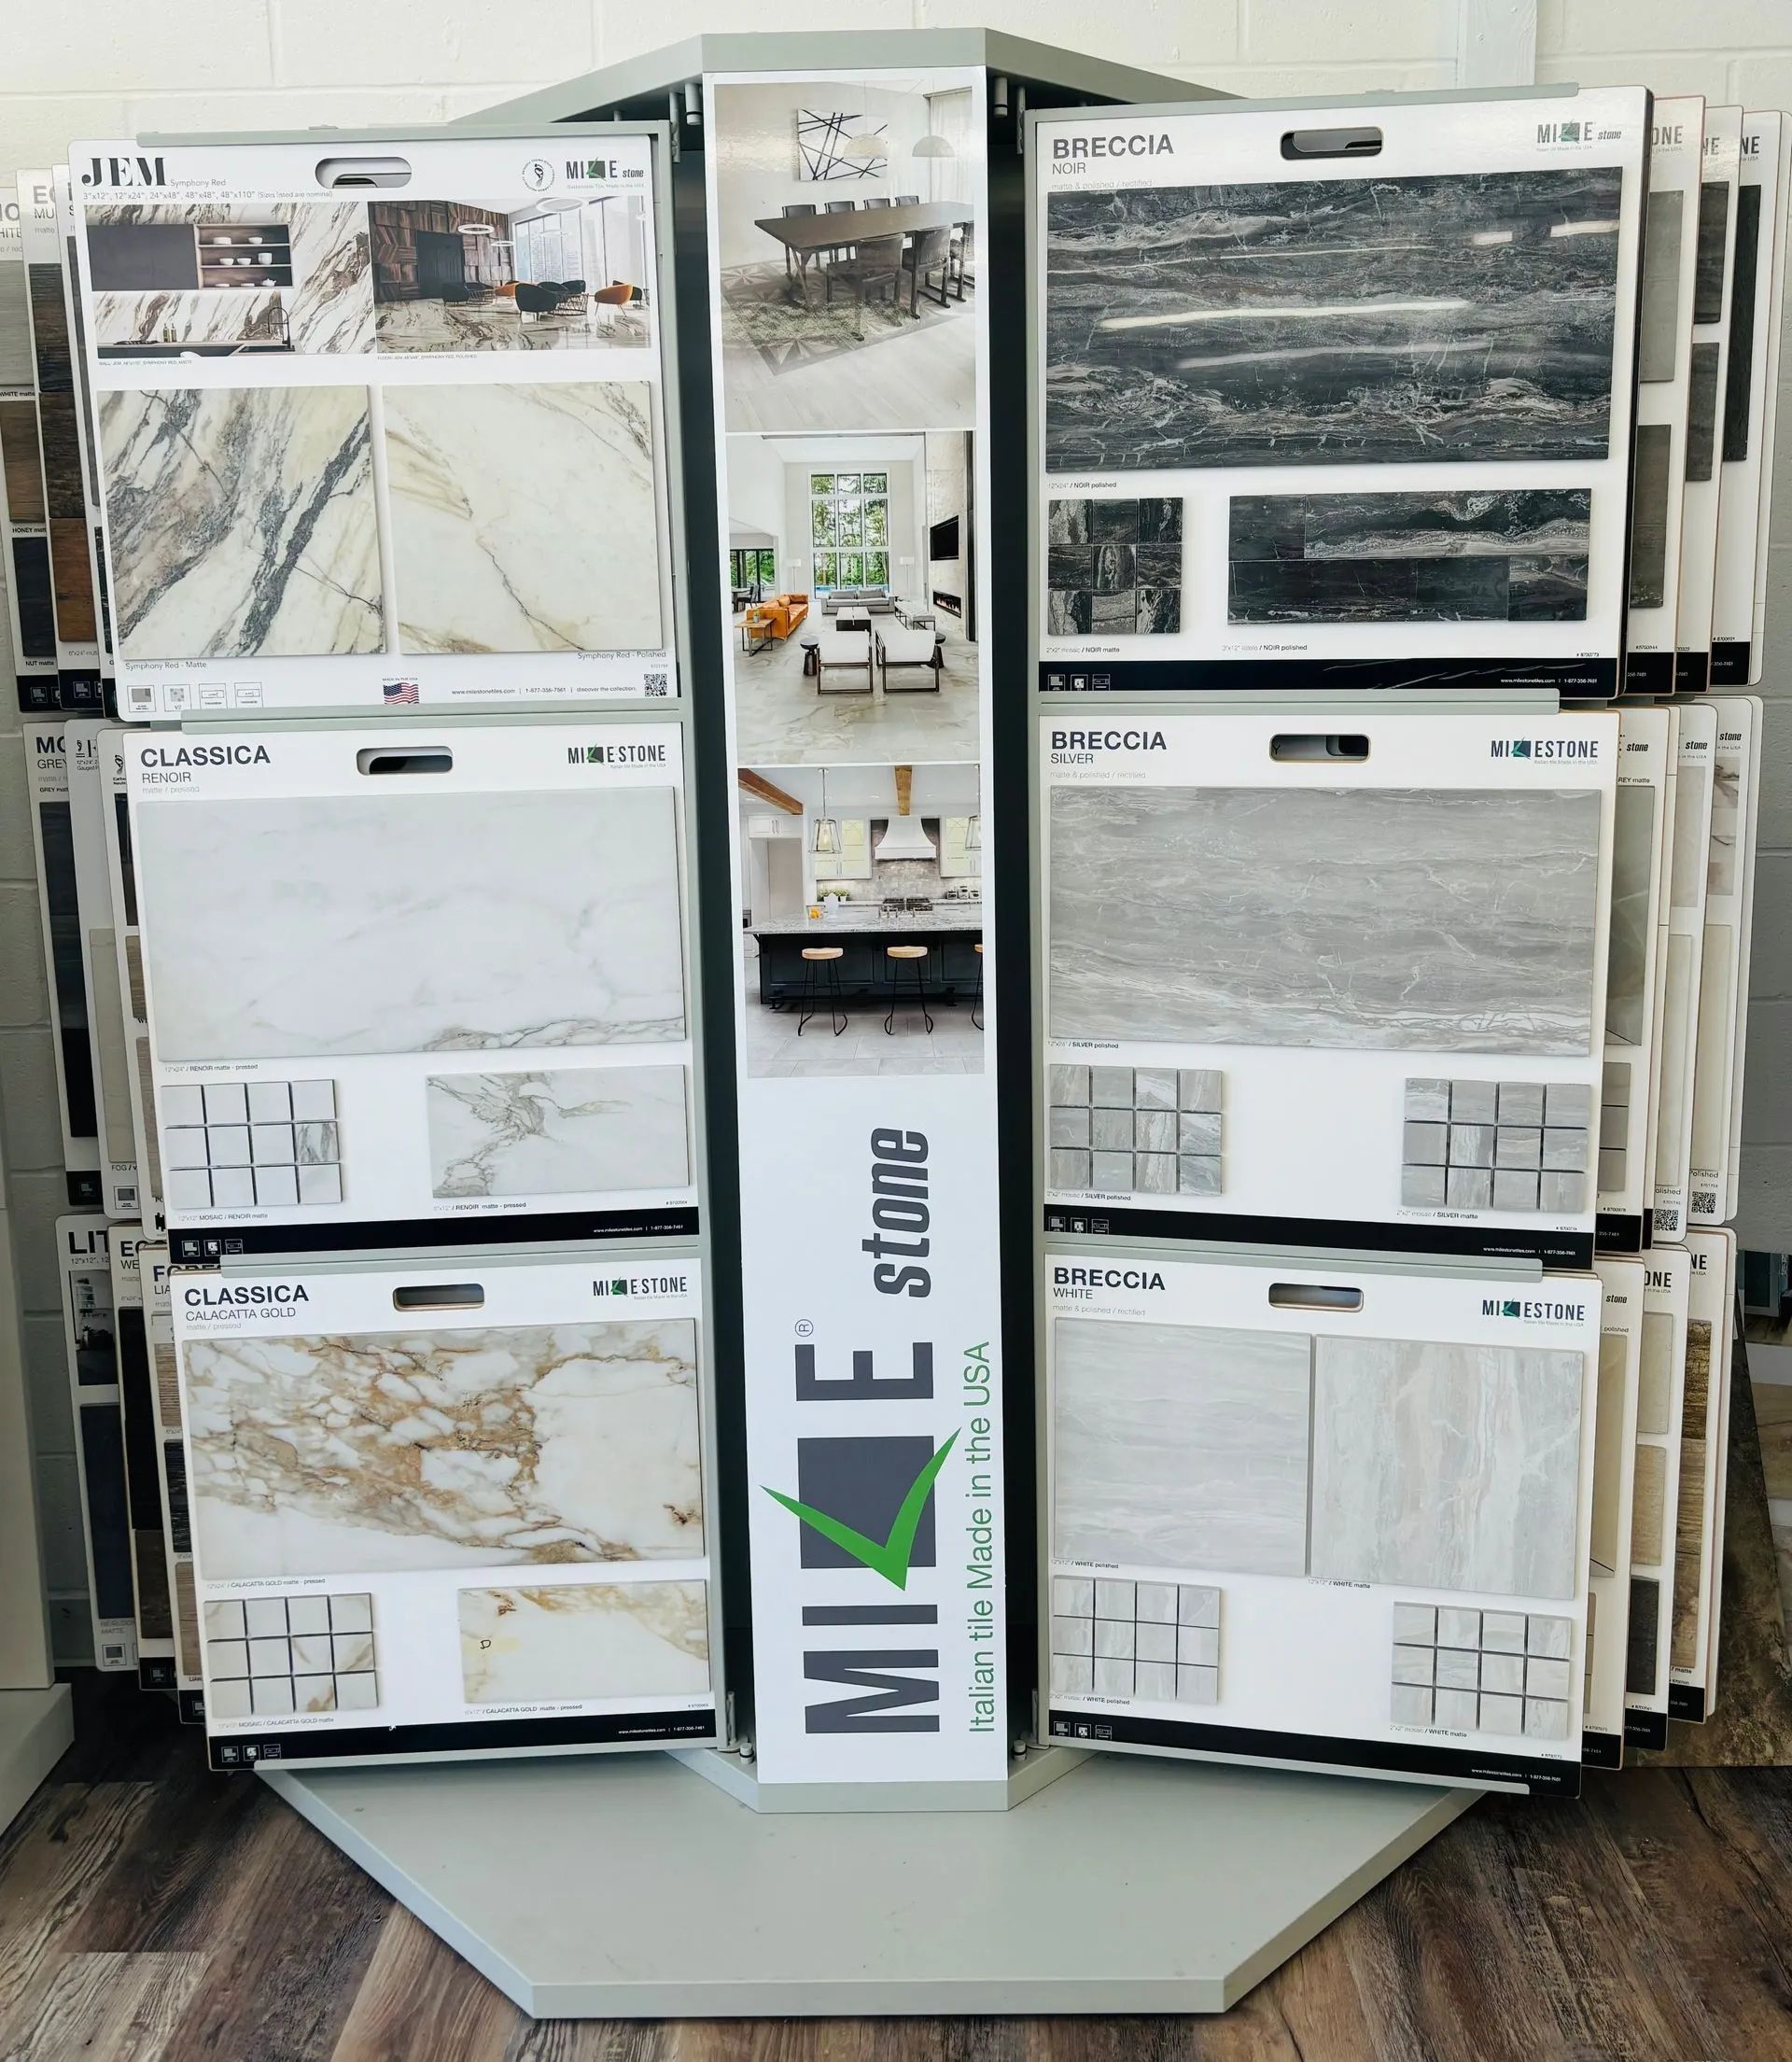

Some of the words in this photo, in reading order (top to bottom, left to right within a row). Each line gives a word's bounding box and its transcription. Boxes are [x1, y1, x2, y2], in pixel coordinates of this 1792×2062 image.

[1597, 130, 1622, 140] stone
[1052, 133, 1174, 160] BRECCIA
[81, 157, 168, 187] JEM
[170, 178, 209, 188] Symphony
[622, 168, 644, 178] stone
[1052, 162, 1086, 175] NOIR
[1051, 182, 1072, 190] matte
[1083, 179, 1114, 189] polished
[1091, 482, 1117, 490] polished
[577, 652, 614, 661] Symphony
[125, 663, 162, 672] Symphony
[1051, 731, 1167, 750] BRECCIA
[1719, 731, 1743, 741] stone
[1626, 742, 1649, 752] stone
[1686, 740, 1708, 750] stone
[141, 745, 271, 768] CLASSICA
[1050, 752, 1094, 764] SILVER
[142, 771, 191, 784] RENOIR
[1079, 771, 1110, 780] polished
[142, 786, 163, 794] matte
[170, 784, 200, 794] pressed
[1094, 1042, 1119, 1050] polished
[861, 1128, 931, 1298] stone
[1053, 1267, 1166, 1291] BRECCIA
[185, 1284, 309, 1307] CLASSICA
[1053, 1287, 1094, 1299] WHITE
[1605, 1294, 1629, 1304] stone
[186, 1308, 258, 1322] CALACATTA
[260, 1307, 296, 1318] GOLD
[1053, 1303, 1073, 1312] matte
[1081, 1304, 1111, 1314] polished
[186, 1322, 206, 1331] matte
[213, 1321, 242, 1331] pressed
[963, 1340, 990, 1407] USA
[964, 1416, 990, 1465] the
[964, 1473, 991, 1499] in
[965, 1508, 993, 1589] Made
[966, 1599, 994, 1642] tile
[968, 1650, 995, 1733] Italian
[1429, 1728, 1449, 1736] WHITE
